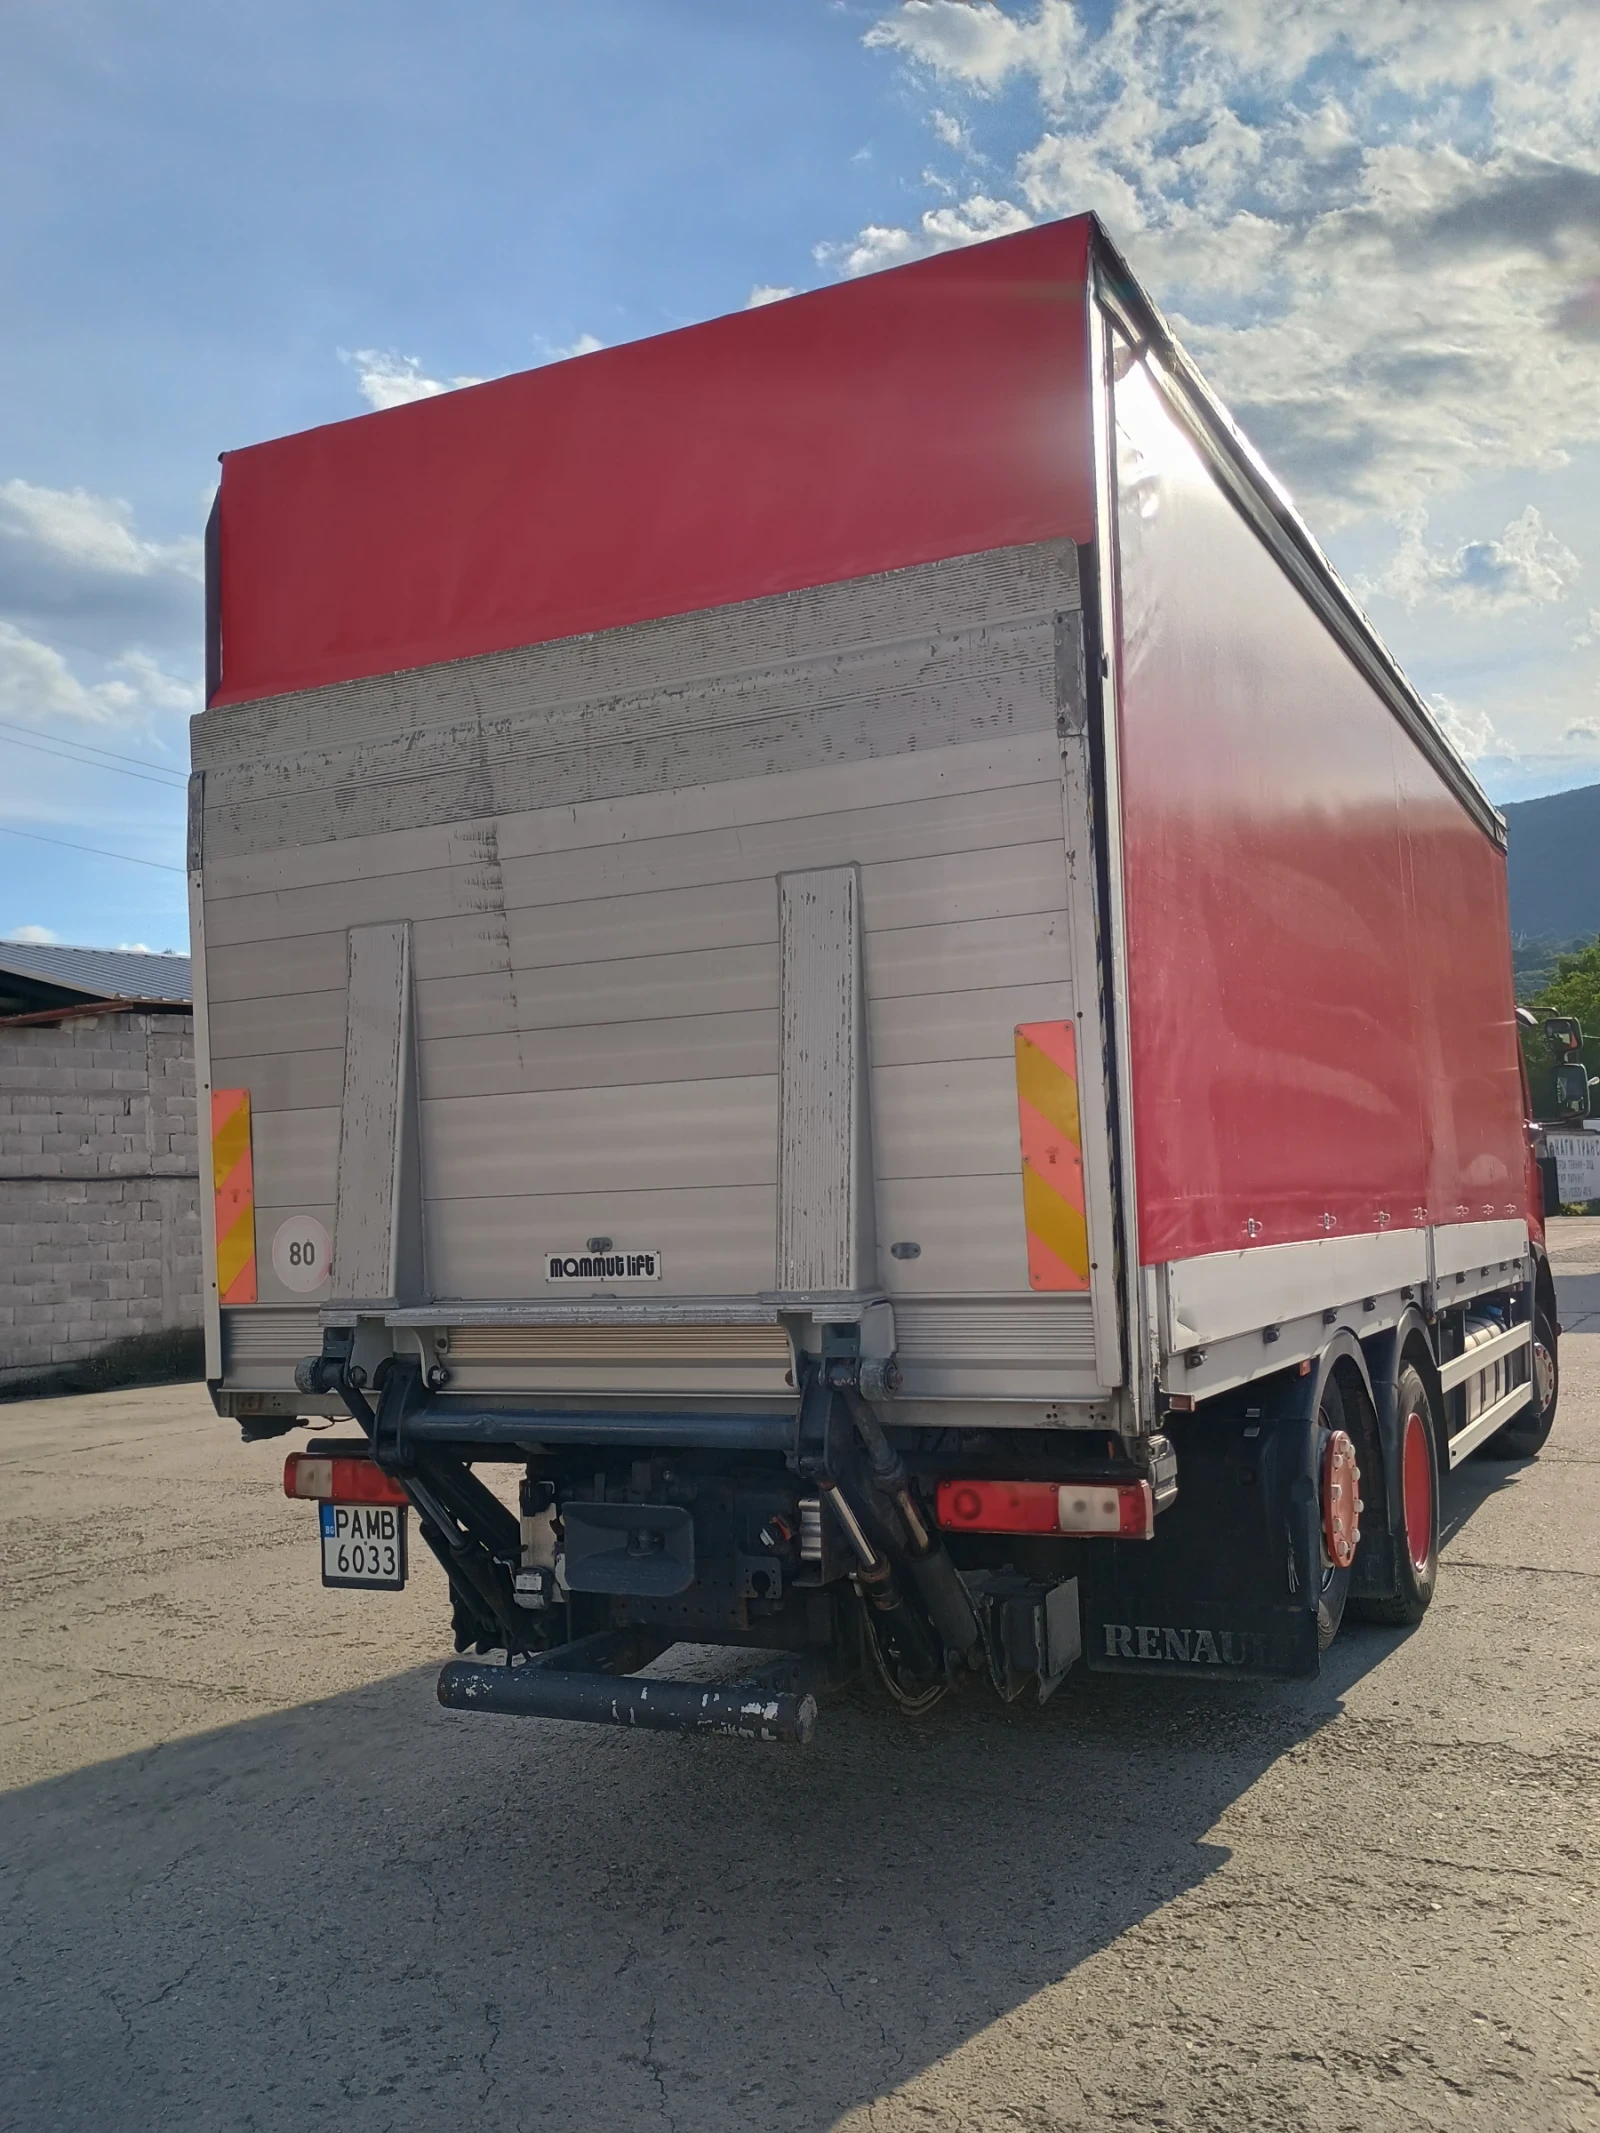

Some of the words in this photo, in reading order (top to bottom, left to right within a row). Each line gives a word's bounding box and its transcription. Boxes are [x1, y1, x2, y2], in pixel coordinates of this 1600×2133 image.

[290, 1241, 315, 1266] 80
[550, 1255, 624, 1278] mammut
[626, 1254, 655, 1276] lift
[325, 1525, 335, 1534] BG
[335, 1509, 395, 1540] PAMB
[337, 1544, 396, 1575] 6033
[1102, 1623, 1300, 1667] RENAU
